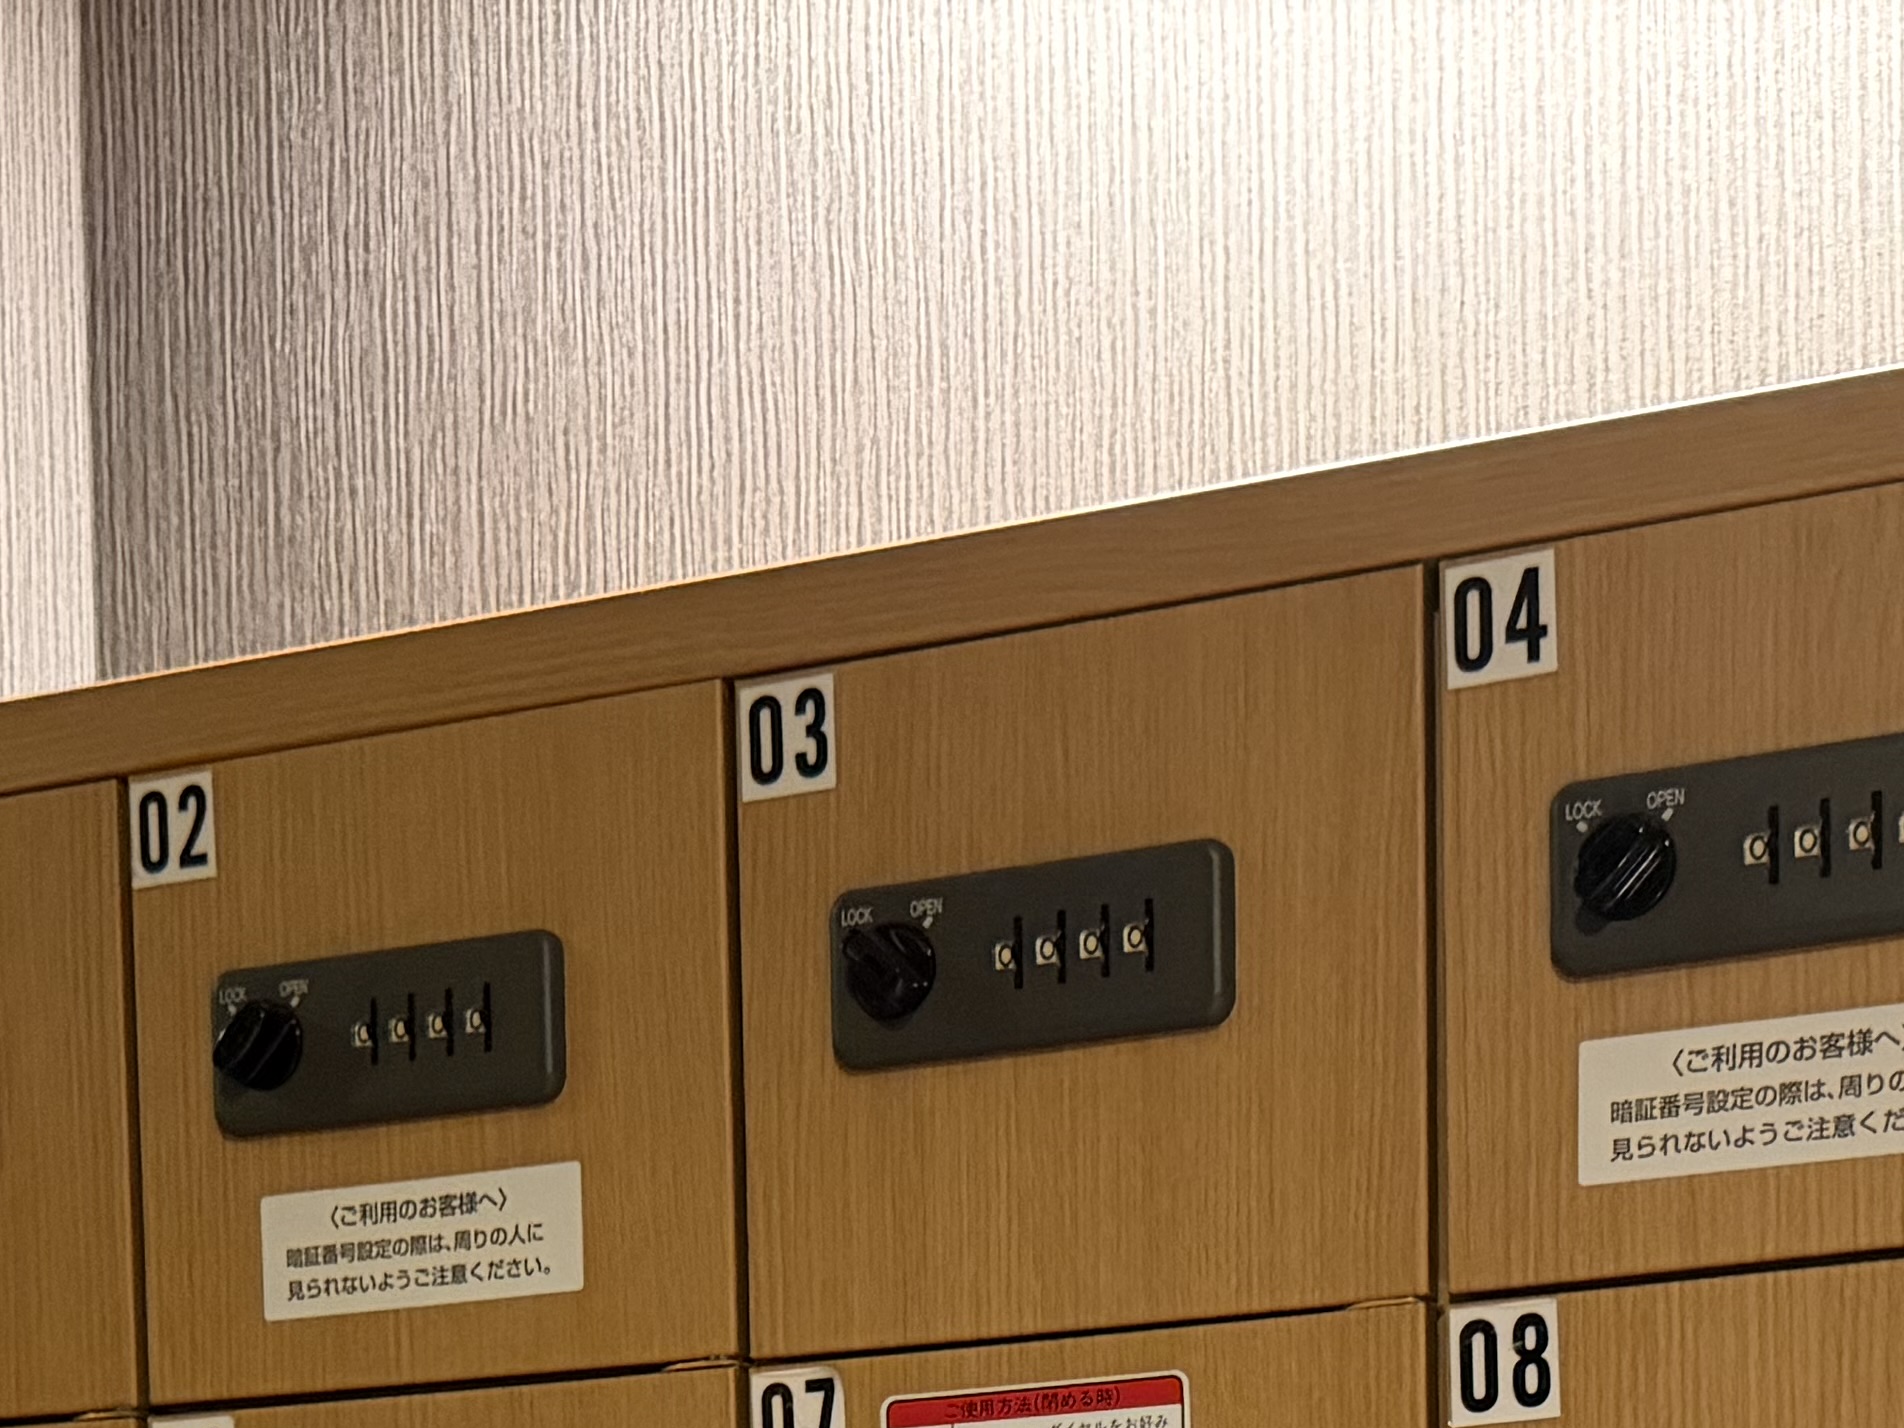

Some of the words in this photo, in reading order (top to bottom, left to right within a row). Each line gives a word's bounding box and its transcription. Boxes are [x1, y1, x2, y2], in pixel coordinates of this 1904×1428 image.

[1453, 566, 1548, 672] 04
[749, 687, 829, 785] 03
[1566, 799, 1602, 819] LOCK
[1647, 787, 1684, 809] OPEN
[138, 785, 208, 874] 02
[841, 906, 873, 927] LOCK
[910, 898, 942, 918] OPEN
[286, 1222, 544, 1269] 暗証番号設定の際は、周りの人に
[288, 1257, 551, 1302] 見られないようご注意ください。
[1459, 1313, 1551, 1413] 08
[945, 1386, 1120, 1420] ご使用方法(閉める時)
